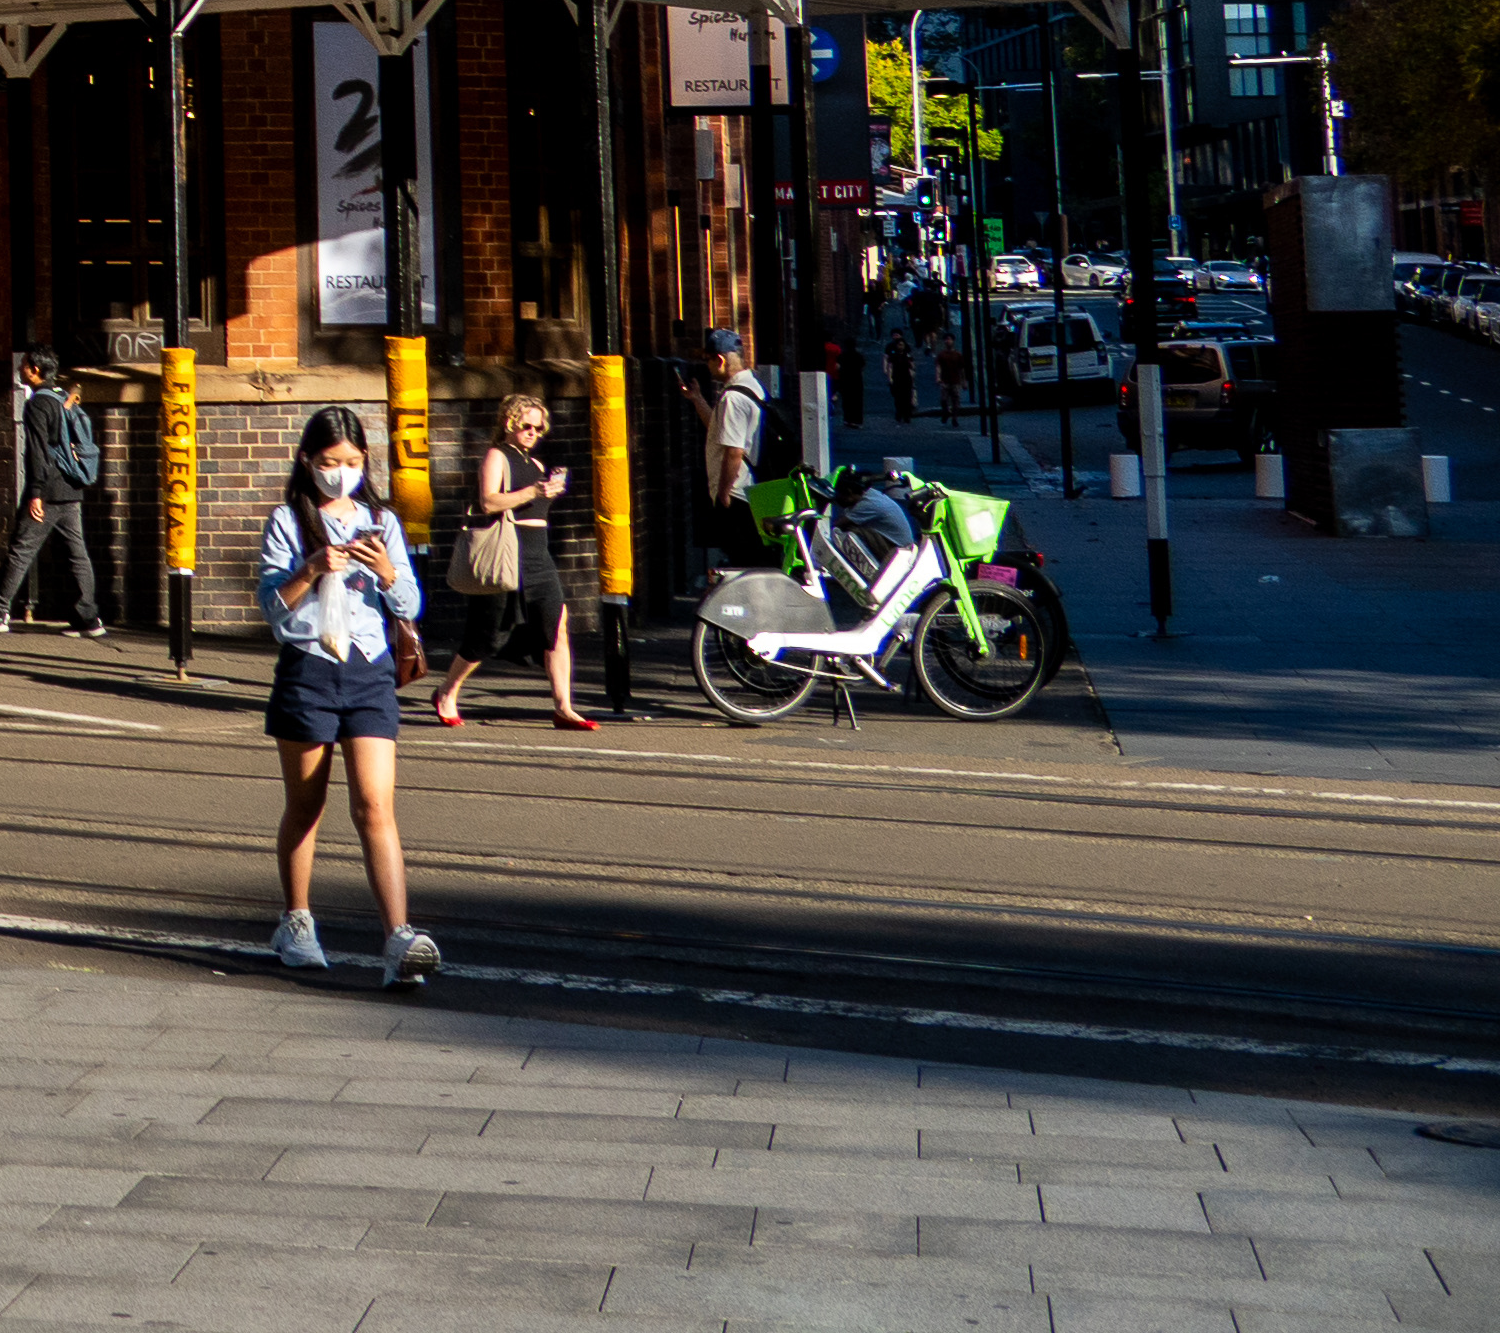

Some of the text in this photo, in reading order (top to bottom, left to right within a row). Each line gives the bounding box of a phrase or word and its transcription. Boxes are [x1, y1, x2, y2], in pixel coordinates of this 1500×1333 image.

[688, 11, 740, 32] Spices
[685, 78, 782, 92] RESTAURT
[834, 185, 863, 198] CITY
[336, 199, 381, 220] Spices
[325, 274, 429, 289] RESTAUT
[828, 556, 867, 606] Lime
[882, 579, 921, 630] Lime
